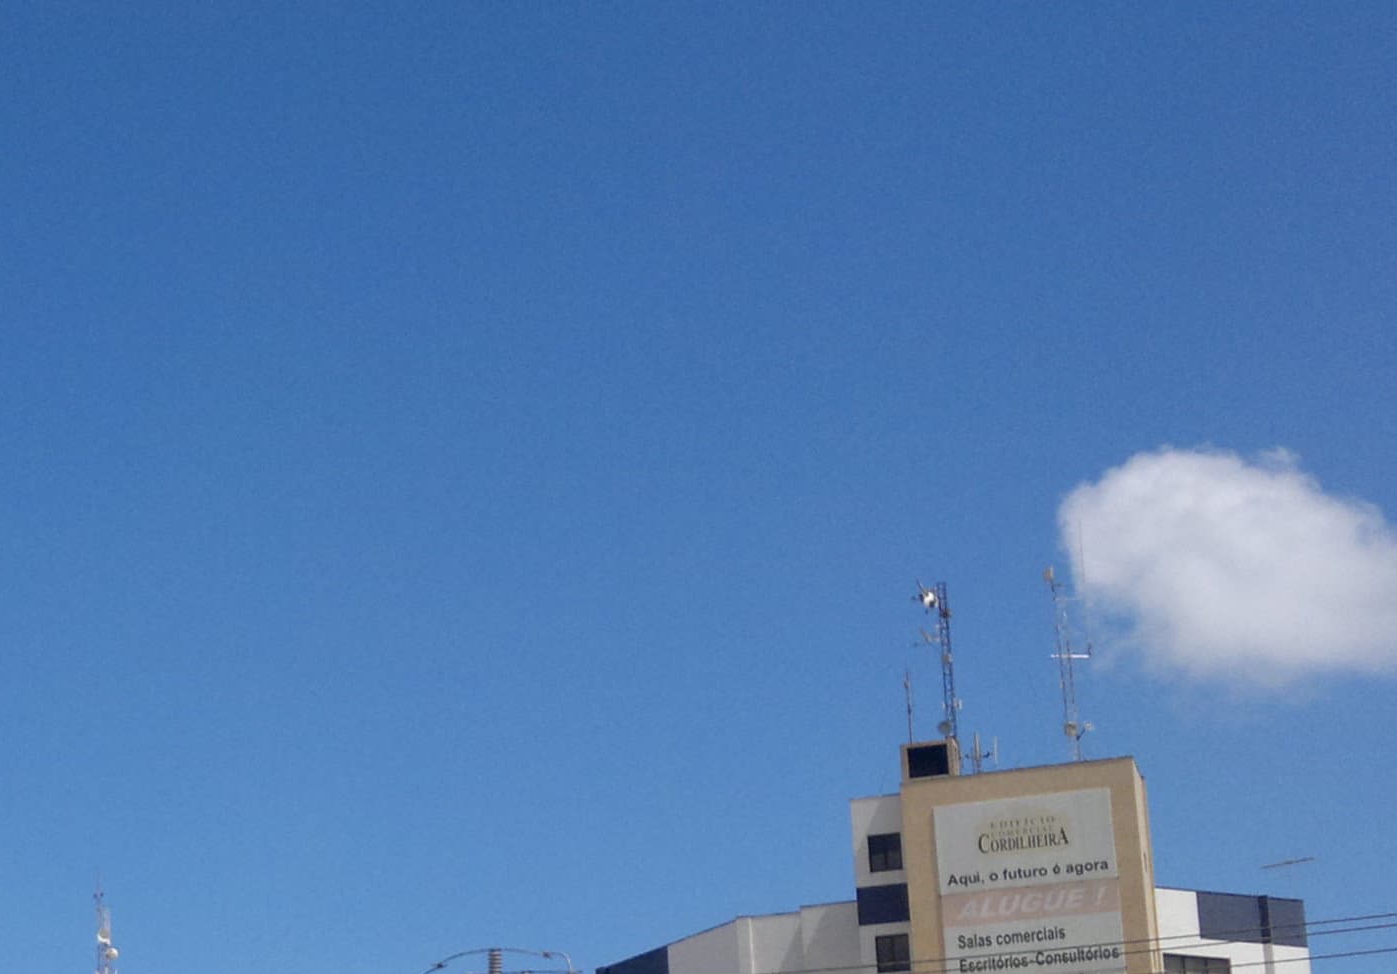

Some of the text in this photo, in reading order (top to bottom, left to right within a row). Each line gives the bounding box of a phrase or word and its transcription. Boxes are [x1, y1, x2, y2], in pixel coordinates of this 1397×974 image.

[978, 827, 1069, 854] CORDILHEIRA
[947, 871, 985, 887] Aqui,
[989, 871, 999, 882] o
[1002, 865, 1048, 881] futuro
[1065, 860, 1109, 876] agora
[957, 887, 1084, 921] ALUGUE
[958, 926, 1066, 950] Salas comerciais
